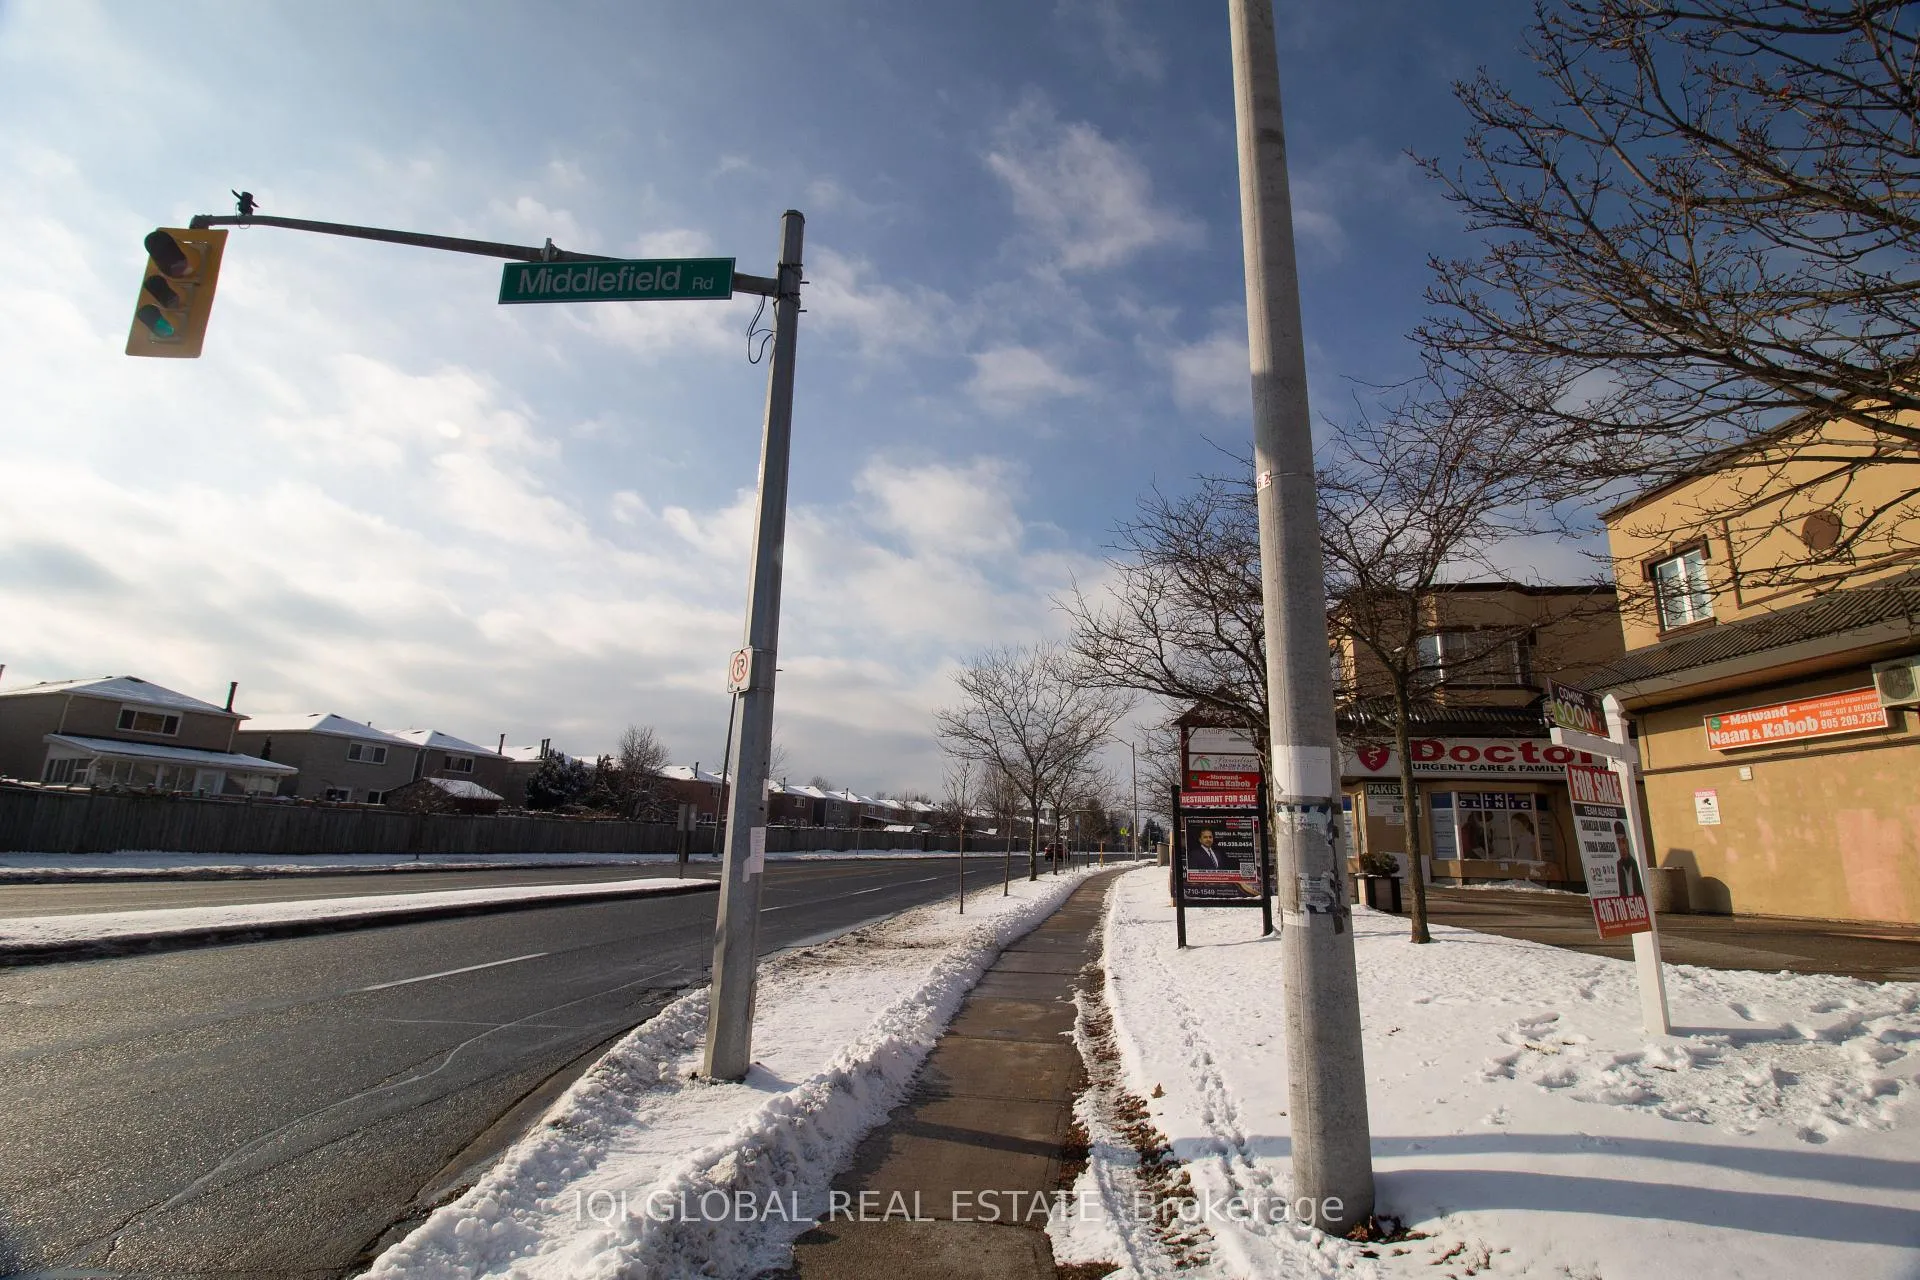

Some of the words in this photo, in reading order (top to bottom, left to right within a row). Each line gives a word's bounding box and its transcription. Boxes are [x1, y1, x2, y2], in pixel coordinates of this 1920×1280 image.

[517, 265, 682, 294] Middlefield
[692, 276, 714, 291] Rd
[1558, 686, 1585, 706] COMING
[1556, 698, 1595, 731] SOON
[1821, 718, 1839, 730] 905
[1840, 710, 1884, 727] 209.7373
[1709, 728, 1750, 745] Naan
[1752, 728, 1761, 739] &
[1762, 716, 1819, 738] Kabob
[1412, 763, 1465, 772] URGENT
[1469, 763, 1504, 772] CARE
[1508, 764, 1516, 772] &
[1518, 764, 1566, 772] FAMILY
[1199, 779, 1220, 787] Naan
[1225, 779, 1251, 788] Kabob
[1571, 768, 1596, 801] FOR
[1593, 771, 1622, 804] SALE
[1181, 795, 1222, 803] RESTAURANT
[1225, 795, 1238, 803] FOR
[1240, 794, 1256, 802] SALE
[1459, 800, 1529, 808] CLINIC
[1584, 806, 1598, 816] TEAM
[1598, 898, 1615, 923] 416
[1612, 898, 1628, 922] 710
[1625, 896, 1647, 920] 1549
